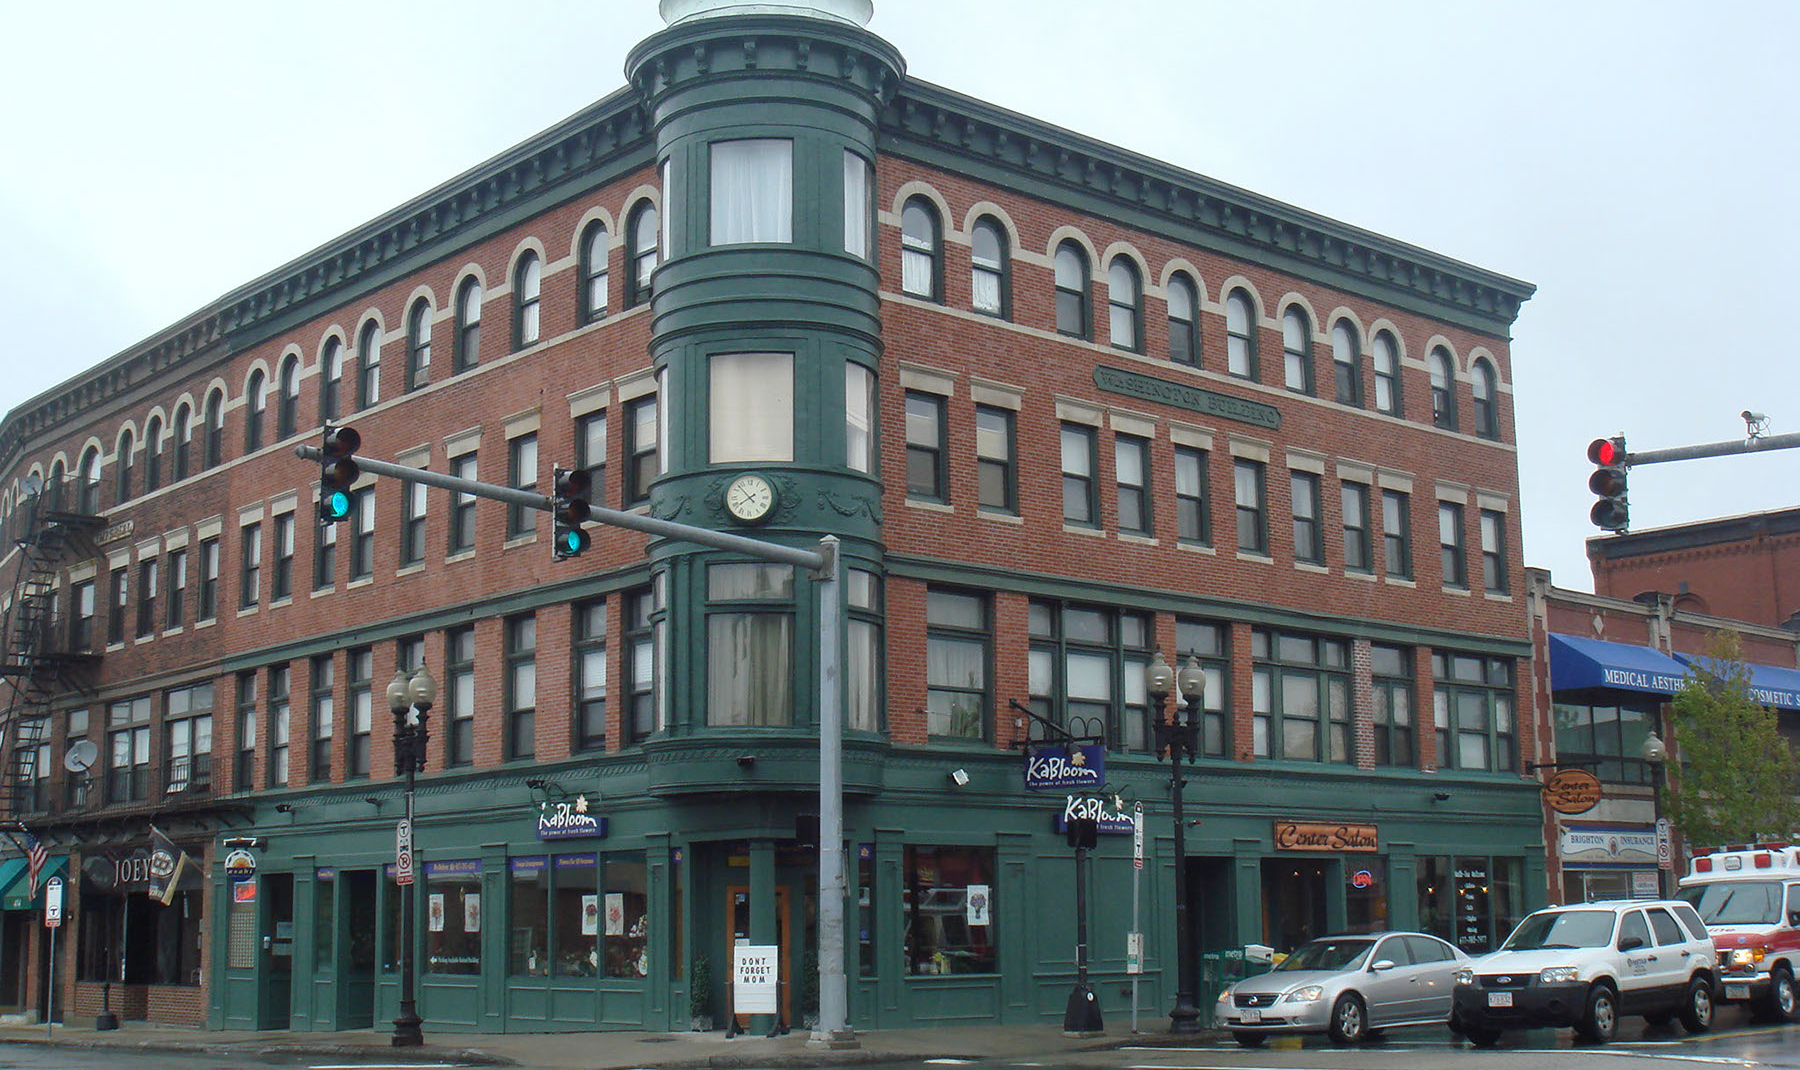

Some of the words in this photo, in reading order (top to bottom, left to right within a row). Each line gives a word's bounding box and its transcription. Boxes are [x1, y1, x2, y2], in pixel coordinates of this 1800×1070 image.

[1604, 668, 1649, 688] MEDICAL
[1027, 756, 1098, 781] KaBloom
[1546, 778, 1590, 793] Center
[1555, 791, 1597, 806] Salon
[1279, 825, 1329, 849] Center
[1332, 826, 1376, 849] Salon
[1570, 835, 1604, 845] BRIGHTON
[1620, 836, 1654, 846] INSURANCE
[1352, 874, 1373, 886] OPEN
[1224, 950, 1243, 960] metro
[741, 957, 767, 966] DONT
[740, 966, 771, 975] FORGET
[743, 975, 766, 984] MOM
